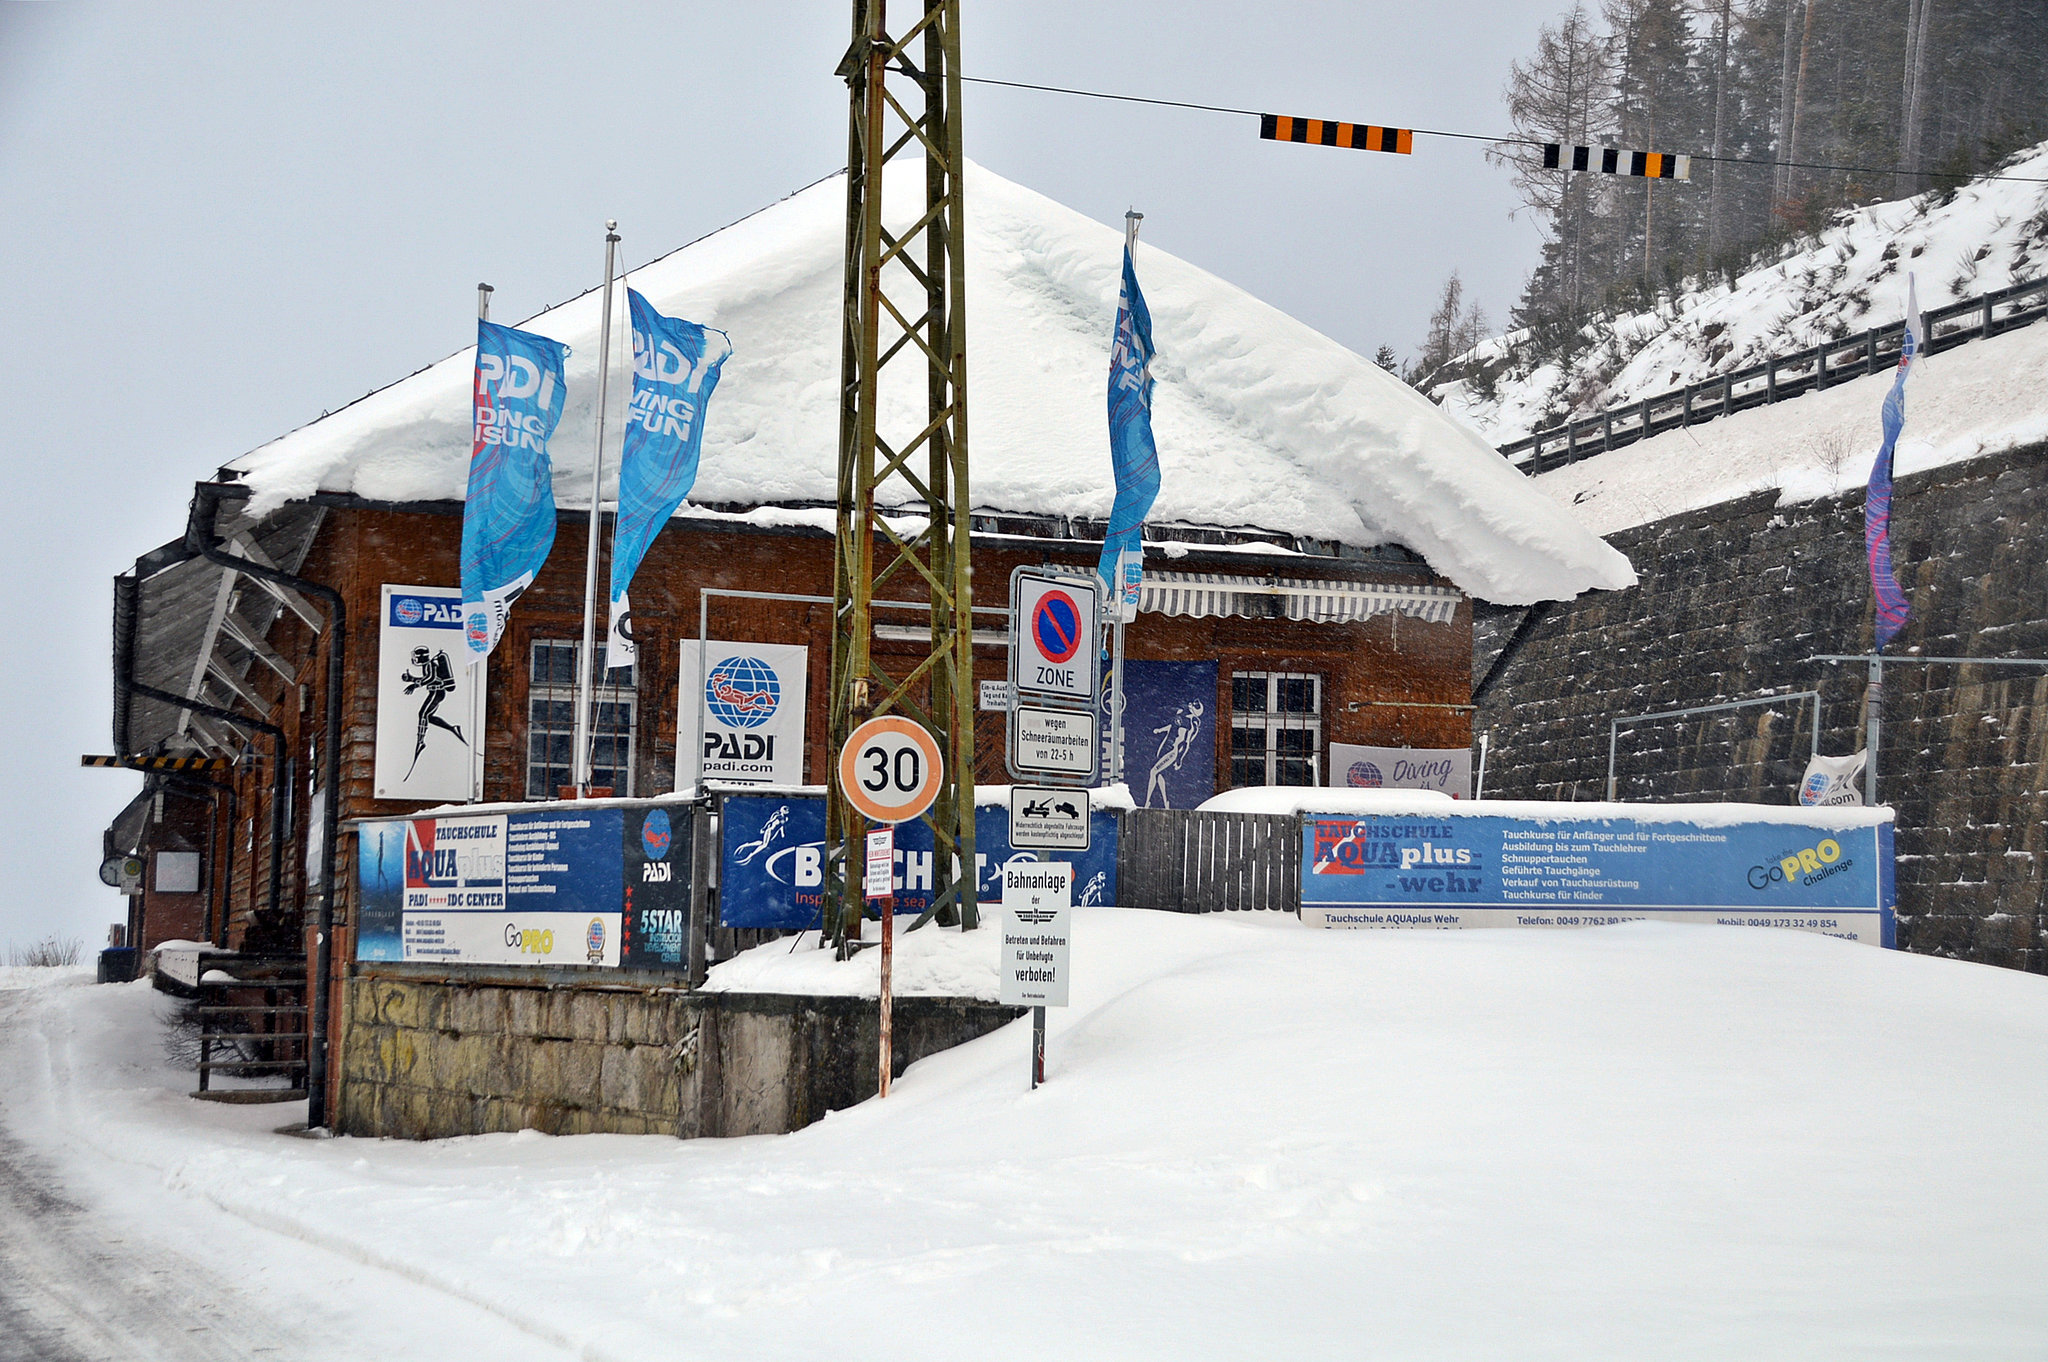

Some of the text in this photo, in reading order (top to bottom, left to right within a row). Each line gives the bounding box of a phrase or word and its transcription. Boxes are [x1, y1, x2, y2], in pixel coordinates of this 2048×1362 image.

[1036, 666, 1075, 688] ZONE
[1045, 718, 1067, 731] wegen
[1021, 729, 1089, 747] Schneeräumarbeiten
[704, 732, 774, 761] PADI
[1035, 749, 1048, 759] von
[1069, 750, 1074, 761] h
[703, 761, 773, 773] padi.com
[863, 746, 920, 792] 30
[1392, 759, 1453, 787] Diving
[436, 825, 498, 841] TAUCHSCHULE
[1315, 825, 1453, 839] TAUCHSCHULE
[1502, 830, 1727, 843] Tauchkurse für Anfänger und für Fortgeschrittene
[1502, 842, 1647, 853] Ausbildung bis zum Tauchlehrer
[1502, 854, 1588, 865] Schnuppertauchen
[1747, 838, 1841, 890] GoPRO
[643, 862, 671, 882] PADI
[1502, 866, 1600, 876] Geführte Tauchgänge
[1802, 858, 1854, 887] Challenge
[1007, 870, 1066, 894] Bahnanlage
[1502, 878, 1639, 889] Verkauf von Tauchausrüstung
[408, 893, 504, 907] PADI IDC CENTER
[1031, 895, 1040, 904] der
[1502, 890, 1603, 900] Tauchkurse für Kinder
[903, 897, 926, 909] sea
[1325, 914, 1383, 923] Tauchschule
[1385, 914, 1432, 924] AQUAplus
[1434, 914, 1460, 923] Wehr
[1517, 916, 1554, 926] Telefon:
[1556, 917, 1579, 926] 0049
[1582, 917, 1605, 926] 7762
[1716, 918, 1745, 927] Mobil:
[1747, 918, 1771, 927] 0049
[1774, 919, 1790, 928] 173
[1792, 919, 1805, 928] 32
[1806, 919, 1818, 928] 49
[1819, 919, 1838, 928] 854
[504, 922, 554, 955] GoPRO
[1005, 934, 1066, 946] Betreten und Befahren
[1016, 950, 1054, 964] für Unbefugte
[1015, 965, 1056, 983] verboten!
